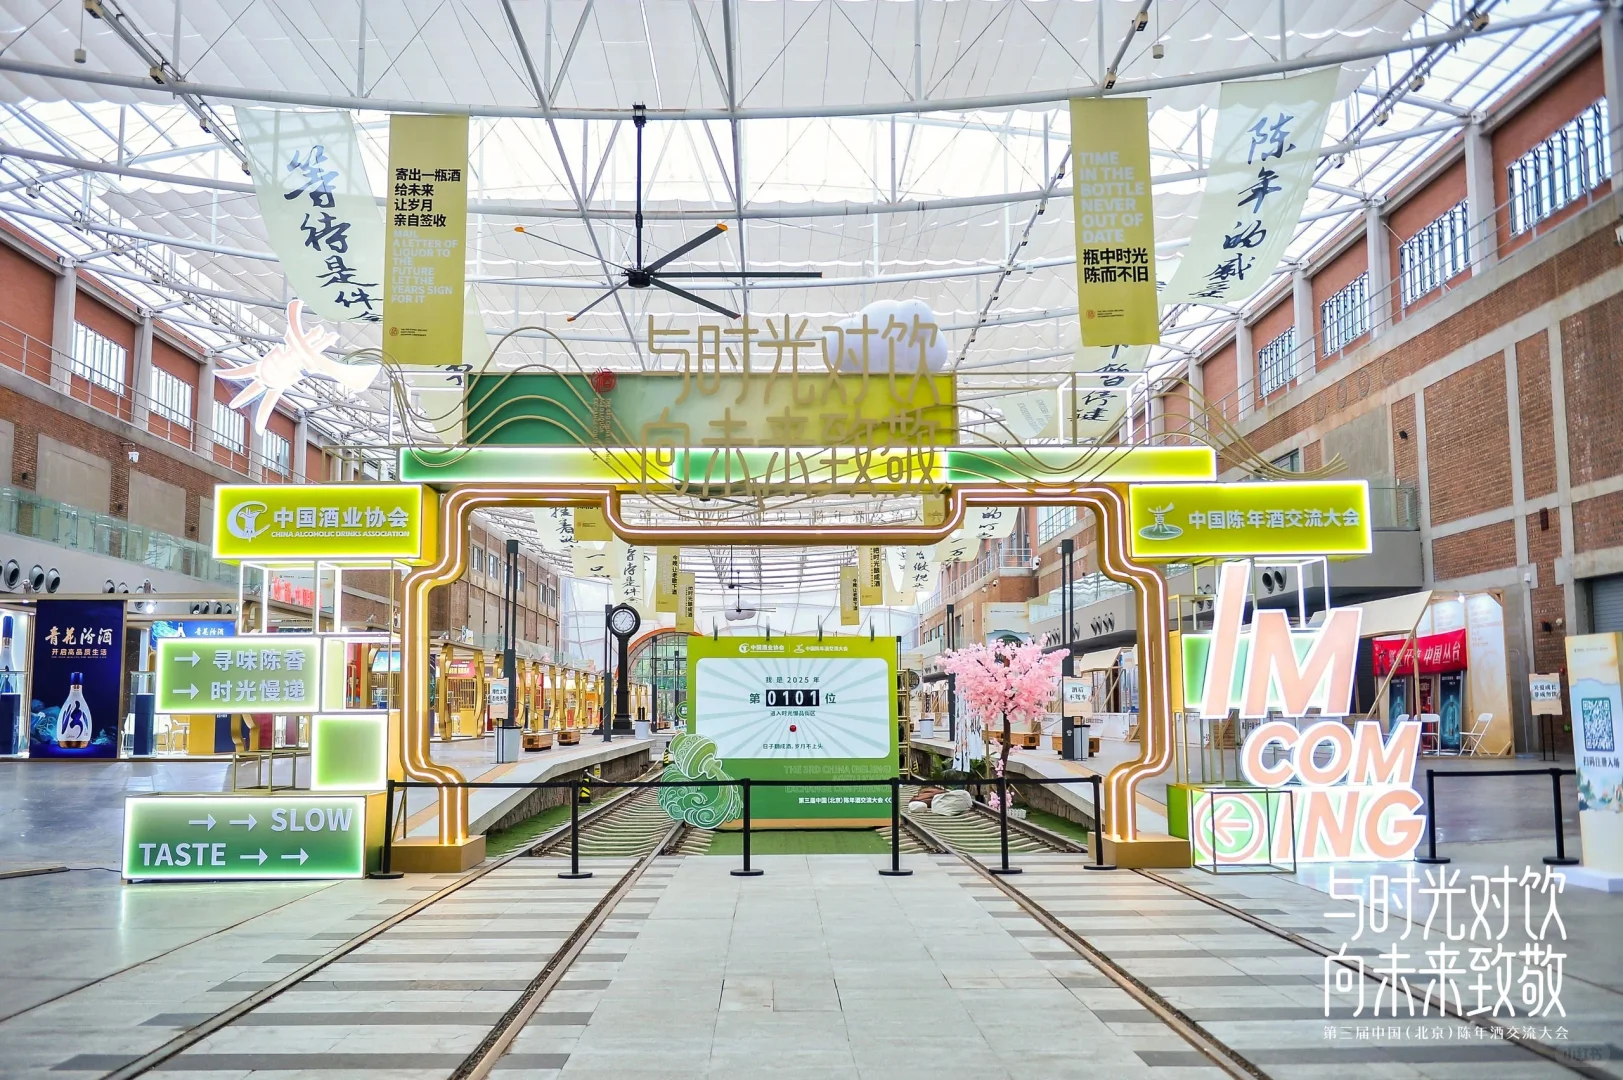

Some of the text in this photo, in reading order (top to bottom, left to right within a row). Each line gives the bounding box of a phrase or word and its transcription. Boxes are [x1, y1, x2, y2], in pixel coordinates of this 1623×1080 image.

[1080, 151, 1119, 165] TIME
[395, 167, 461, 182] 寄出一瓶酒
[1080, 166, 1134, 181] IN THE
[394, 183, 434, 197] 给未来
[1080, 182, 1145, 197] BOTTLE
[394, 198, 433, 212] 让岁月
[1081, 198, 1137, 212] NEVER
[394, 213, 447, 228] 亲自签收
[1082, 213, 1144, 228] OUT OF
[393, 229, 418, 239] MAIL
[1082, 229, 1125, 244] DATE
[393, 239, 459, 249] A LETTER OF
[393, 248, 451, 257] LIQUOR TO
[1083, 247, 1148, 266] 瓶中时光
[392, 257, 413, 266] THE
[392, 266, 435, 276] FUTURE
[1084, 265, 1149, 284] 陈而不旧
[392, 276, 435, 285] LET THE
[391, 285, 454, 295] YEARS SIGN
[391, 294, 426, 304] FOR IT
[641, 314, 940, 405] 与时光对饮
[641, 406, 940, 498] 向未来致敬
[273, 506, 410, 529] 中国酒业协会
[1188, 507, 1361, 530] 中国陈年酒交流大会
[362, 530, 410, 538] ASSOCIATION
[45, 626, 113, 646] 青花汾酒
[51, 648, 108, 656] 开启高品质生活
[212, 648, 305, 672] 寻味陈香
[210, 679, 305, 702] 时光慢递
[749, 690, 836, 705] 第 0101 位
[784, 765, 802, 774] THE
[804, 765, 821, 774] 3RD
[823, 765, 850, 774] CHINA
[1583, 755, 1620, 769] 扫码注册入场
[271, 807, 353, 832] SLOW
[138, 842, 227, 867] TASTE
